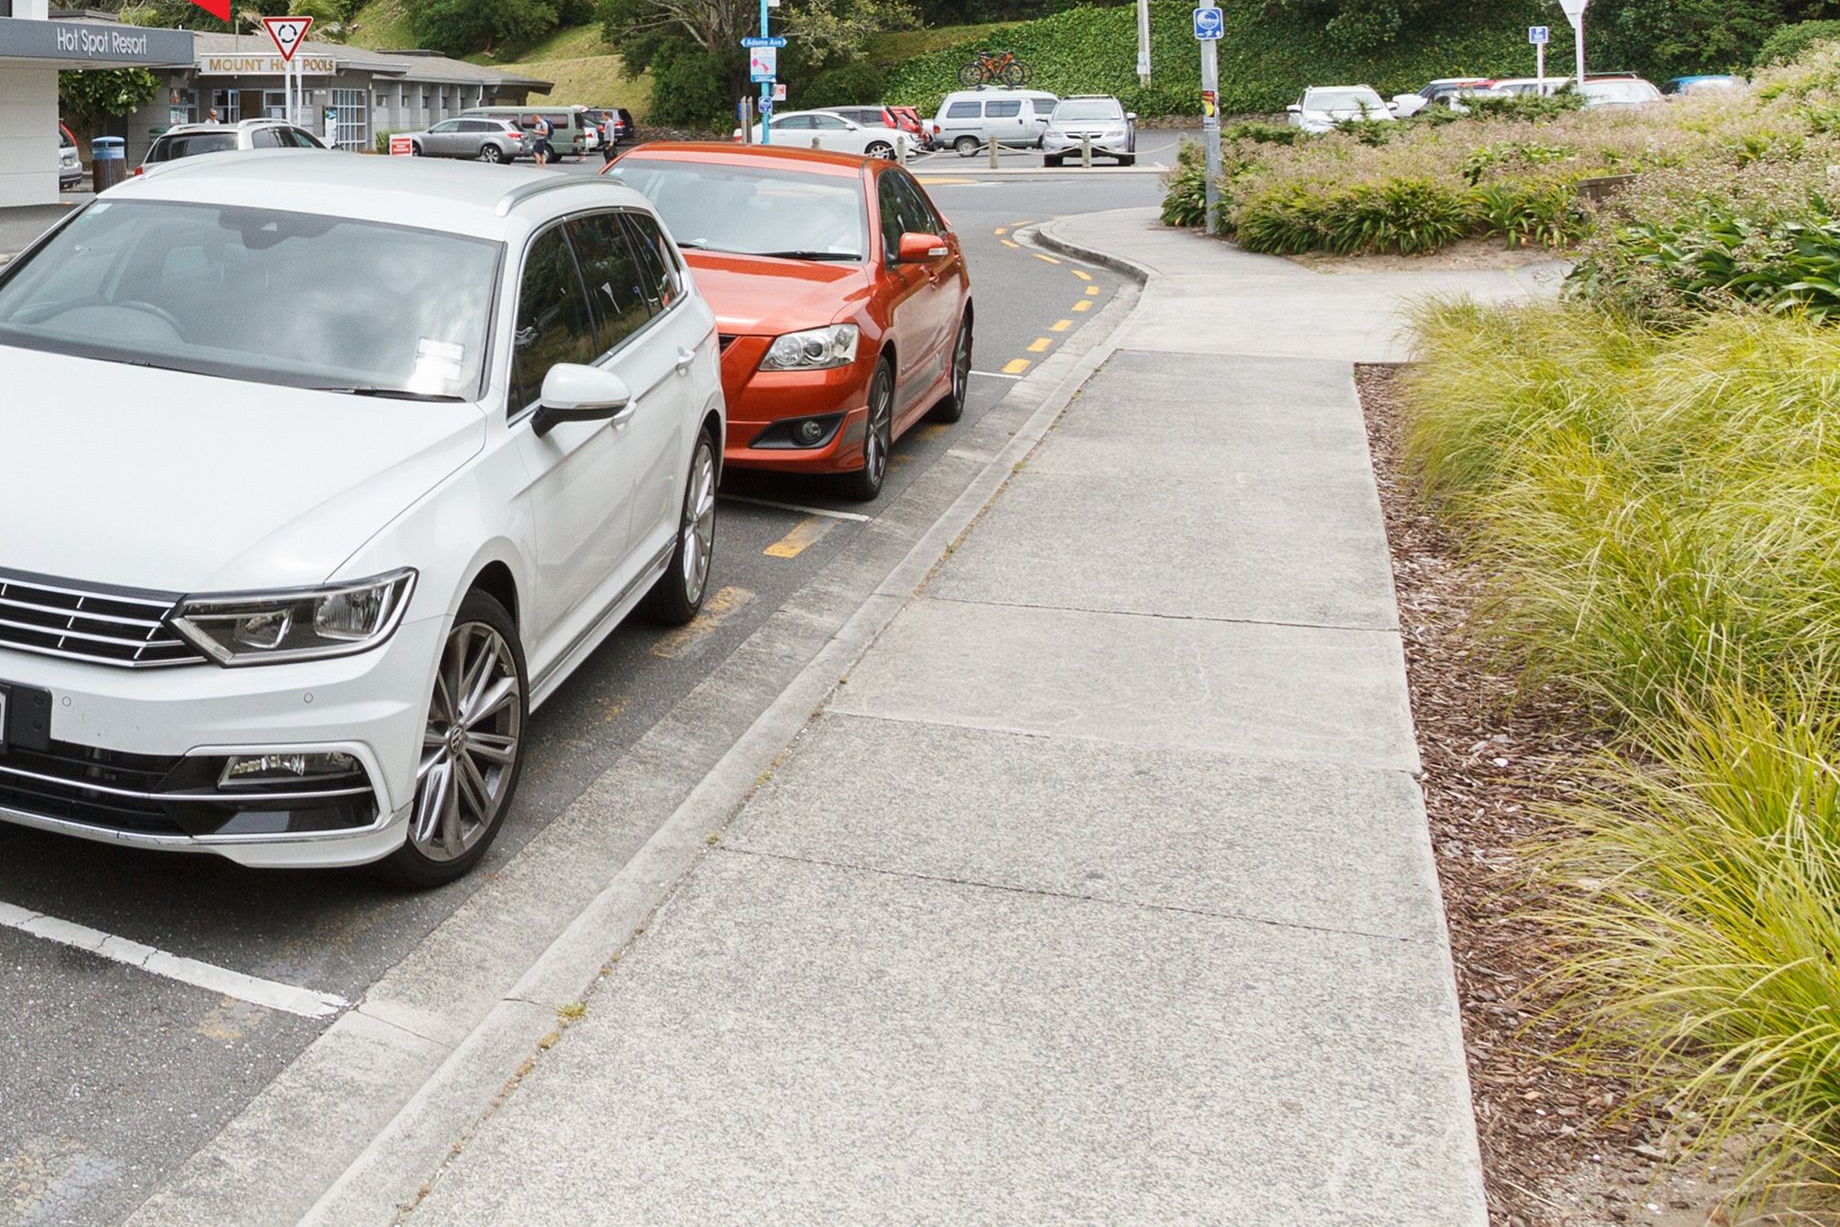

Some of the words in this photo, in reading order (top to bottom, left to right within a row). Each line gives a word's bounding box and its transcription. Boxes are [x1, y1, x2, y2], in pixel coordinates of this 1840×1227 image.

[56, 27, 78, 51] Hot
[81, 29, 108, 56] Spot
[112, 32, 147, 54] Resort
[209, 59, 264, 71] MOUNT
[303, 59, 334, 71] POOLS
